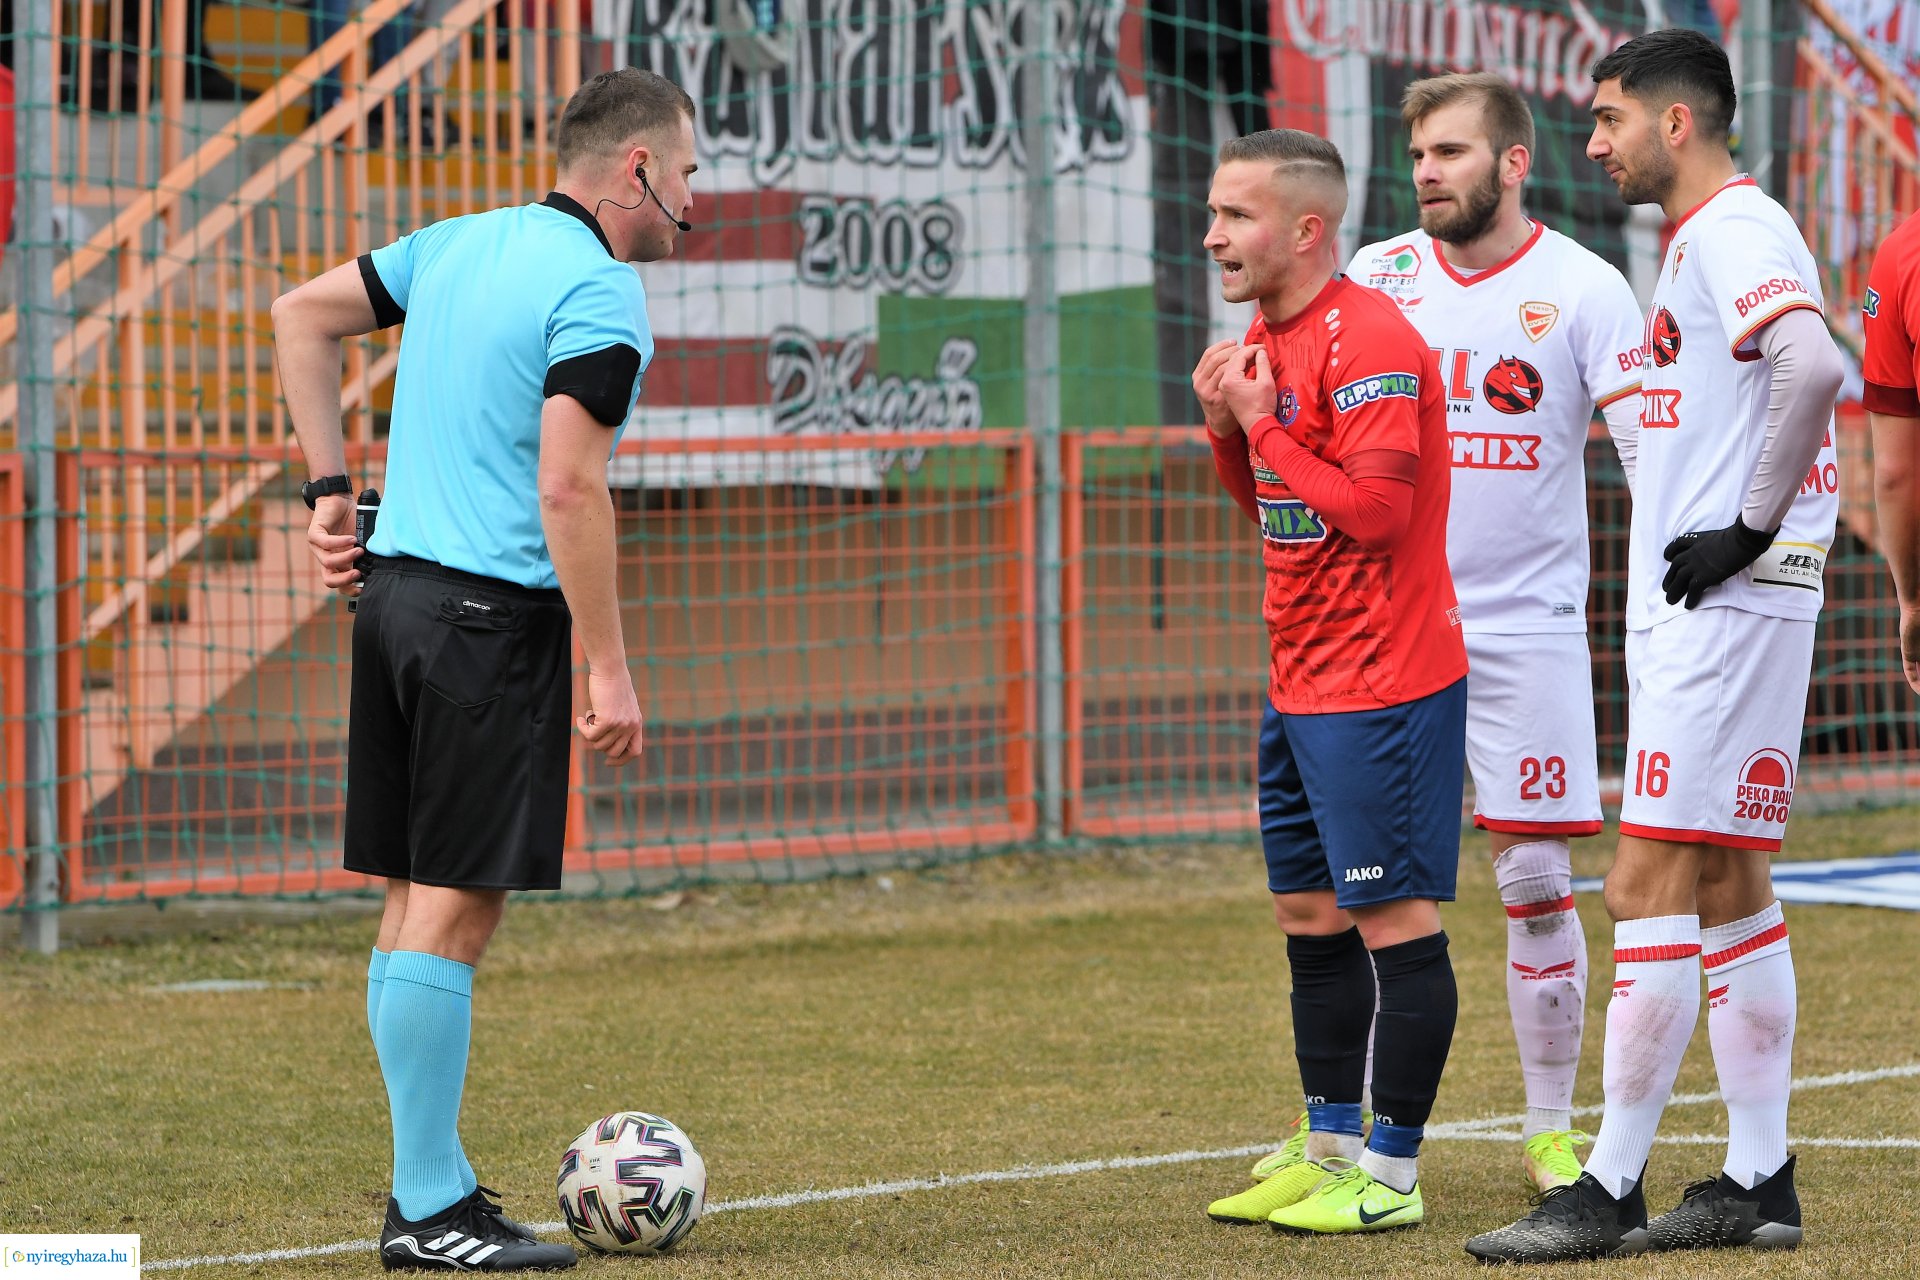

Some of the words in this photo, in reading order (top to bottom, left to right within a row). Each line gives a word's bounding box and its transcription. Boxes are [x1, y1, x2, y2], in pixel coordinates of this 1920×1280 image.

[801, 198, 964, 294] 2008
[1735, 278, 1809, 318] BORSOD
[1446, 404, 1472, 414] INK
[1448, 436, 1536, 466] MIX
[1520, 756, 1566, 800] 23
[1635, 749, 1671, 798] 16
[1737, 785, 1769, 802] PEKA
[1772, 790, 1792, 805] BAU
[1734, 800, 1788, 823] 2000
[1345, 866, 1384, 882] JAKO
